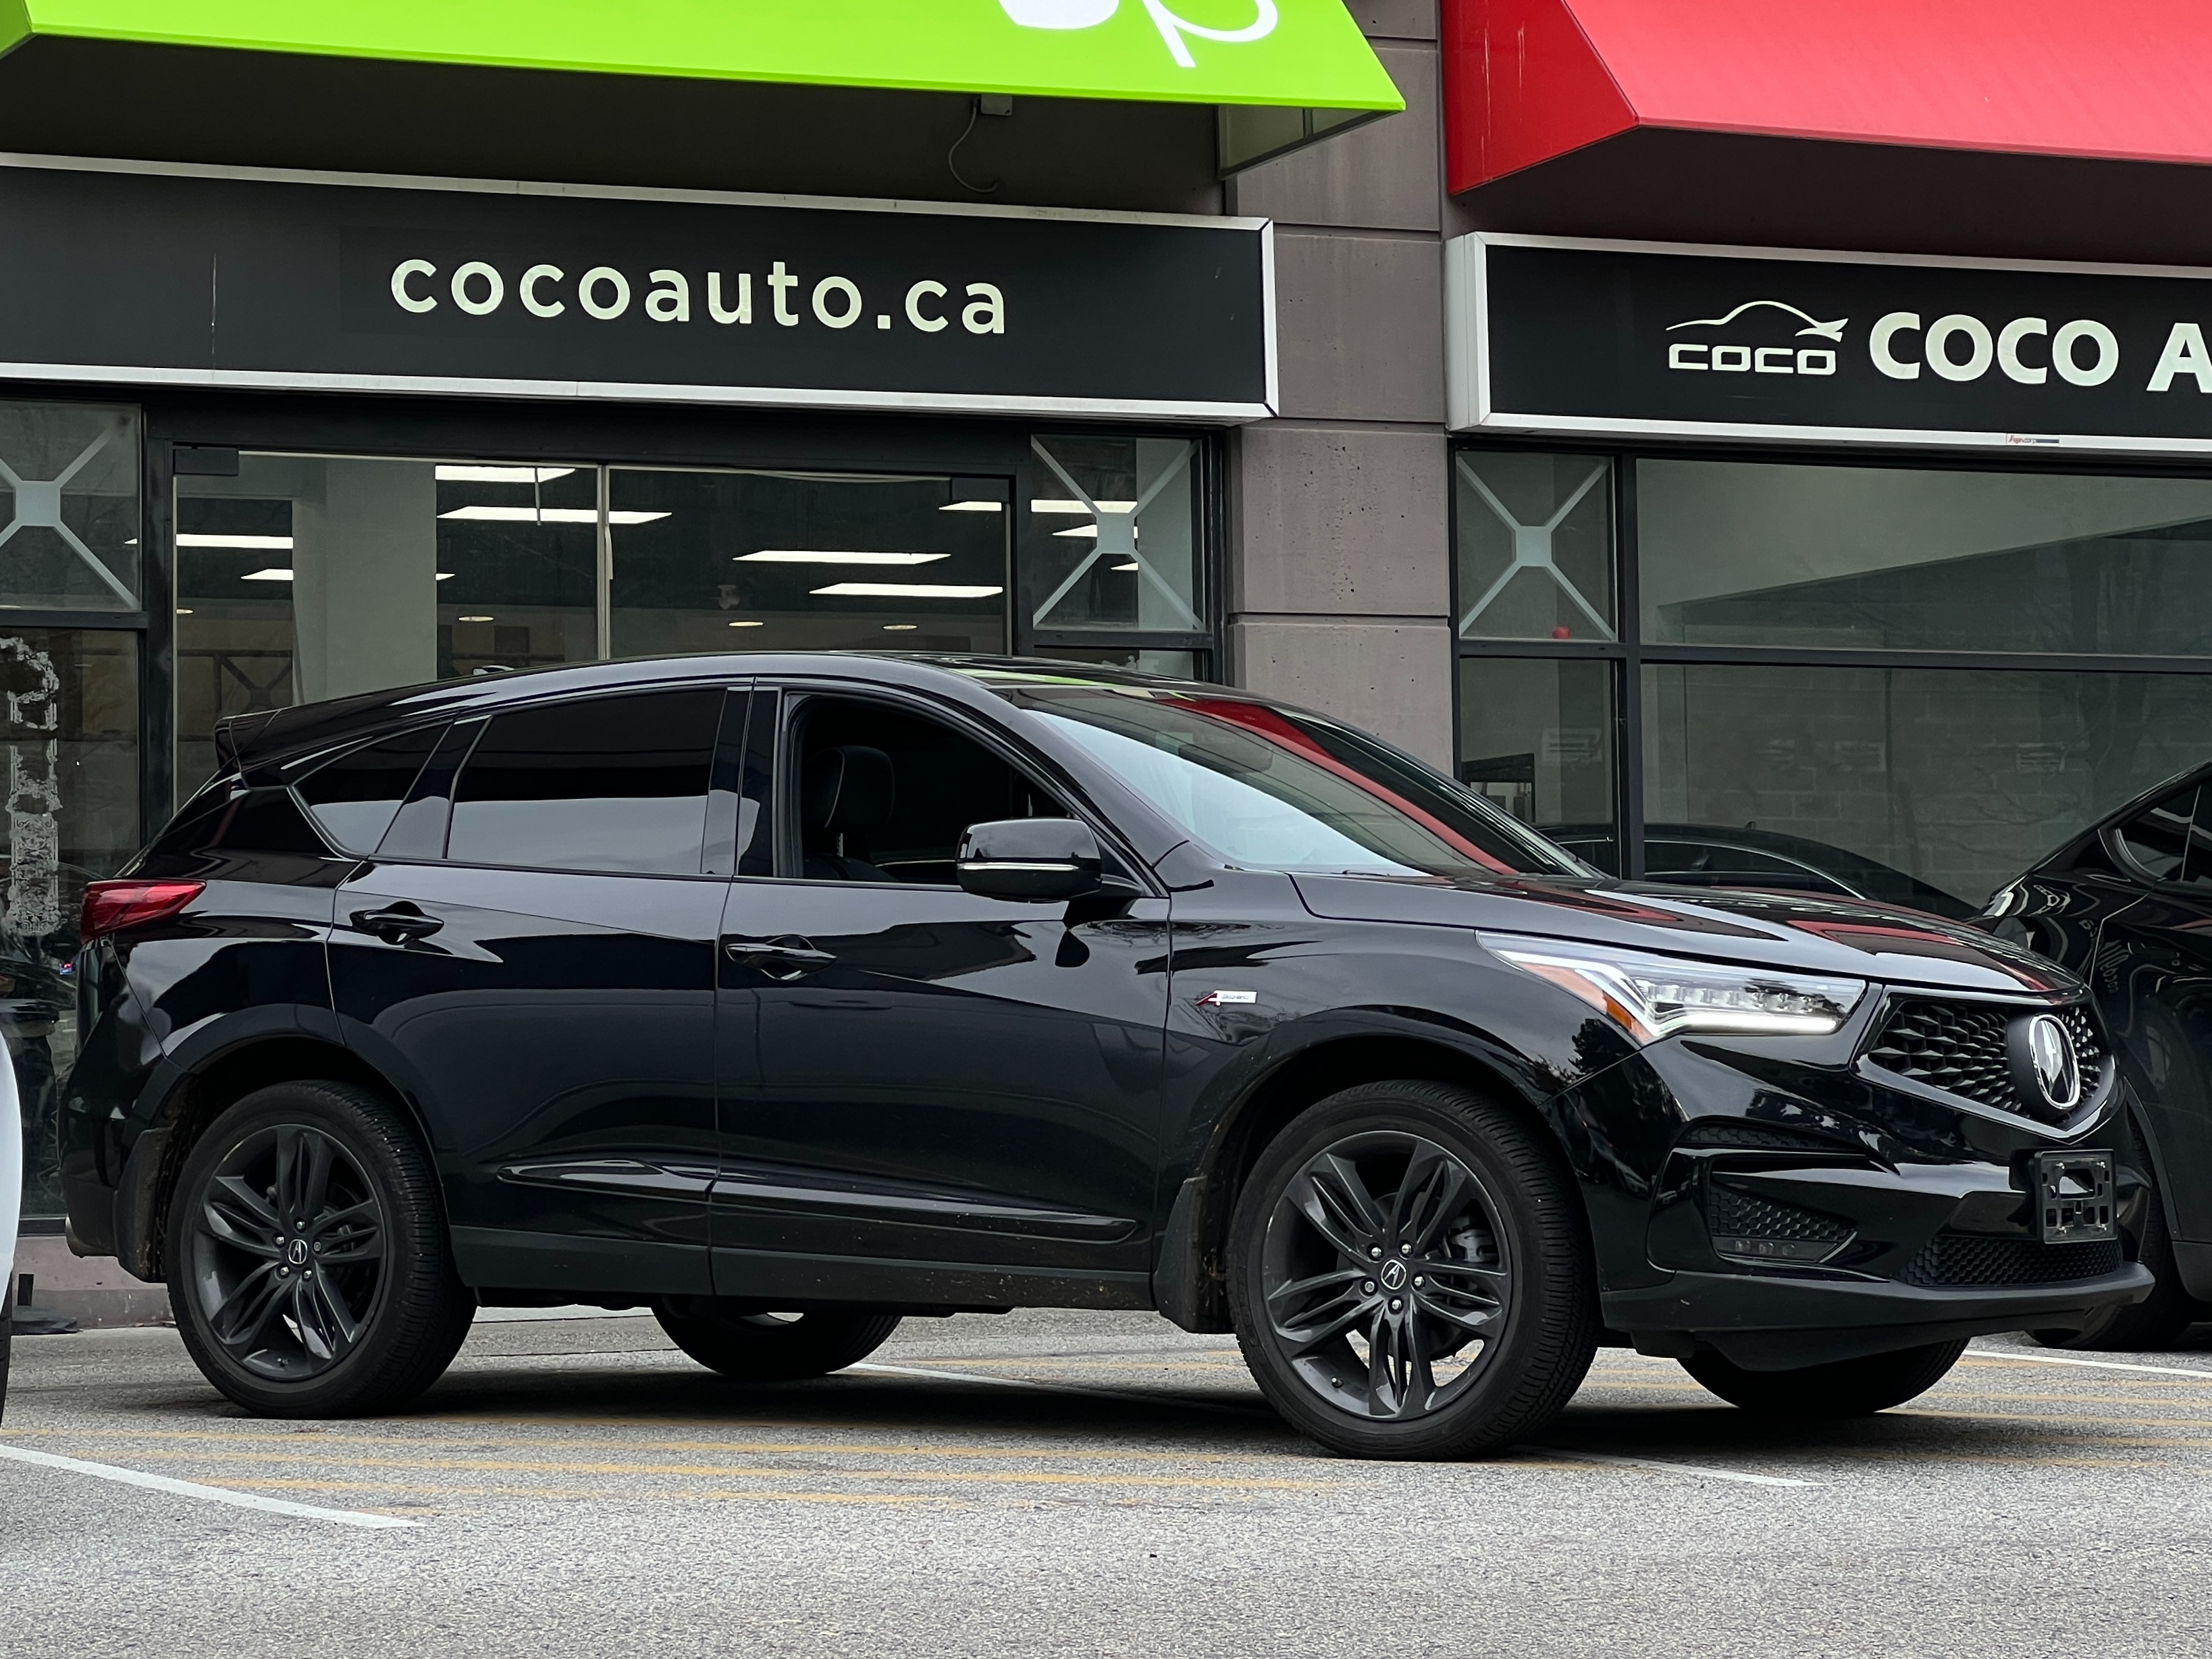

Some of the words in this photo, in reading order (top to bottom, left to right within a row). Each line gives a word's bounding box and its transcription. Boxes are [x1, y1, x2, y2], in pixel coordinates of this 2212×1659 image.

[391, 259, 1005, 334] cocoauto.ca
[1668, 343, 1836, 375] COCO
[1869, 311, 2119, 387] COCO
[2146, 322, 2212, 394] A
